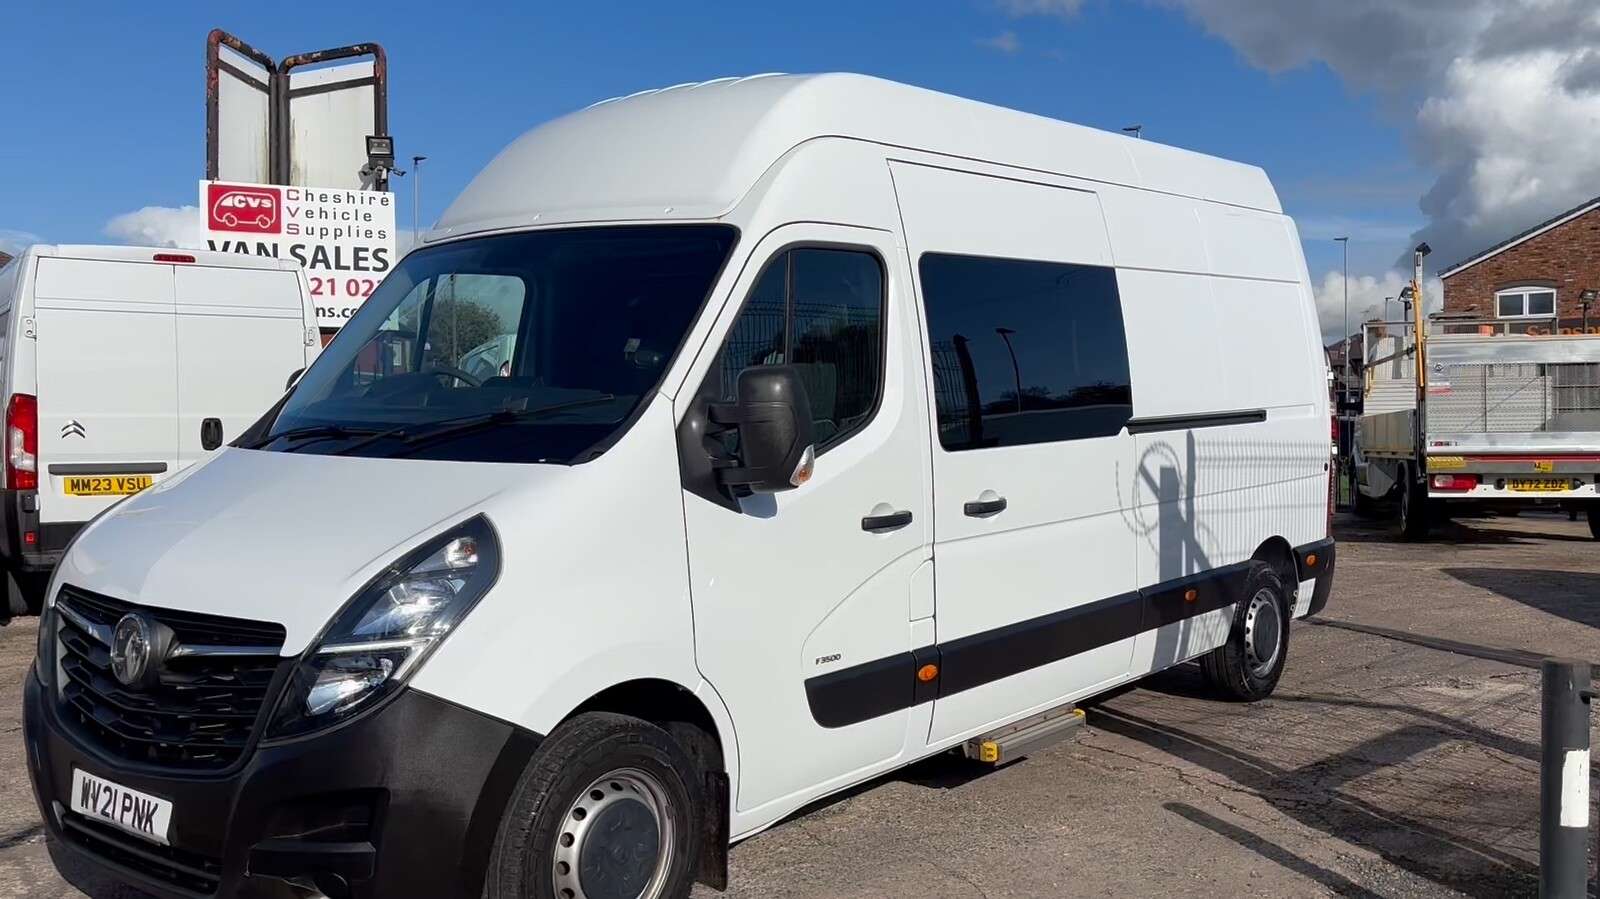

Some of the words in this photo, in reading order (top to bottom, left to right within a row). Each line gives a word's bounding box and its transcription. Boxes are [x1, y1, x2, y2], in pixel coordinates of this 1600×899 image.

[232, 195, 272, 208] CVS
[286, 189, 390, 207] Cheshire
[286, 206, 373, 222] Vehicle
[286, 223, 387, 240] Supplies
[289, 244, 390, 272] SALES
[346, 278, 382, 297] 02
[71, 478, 112, 491] MM23
[116, 478, 146, 490] VSU
[80, 776, 118, 820] WV21
[120, 792, 158, 835] PNK
